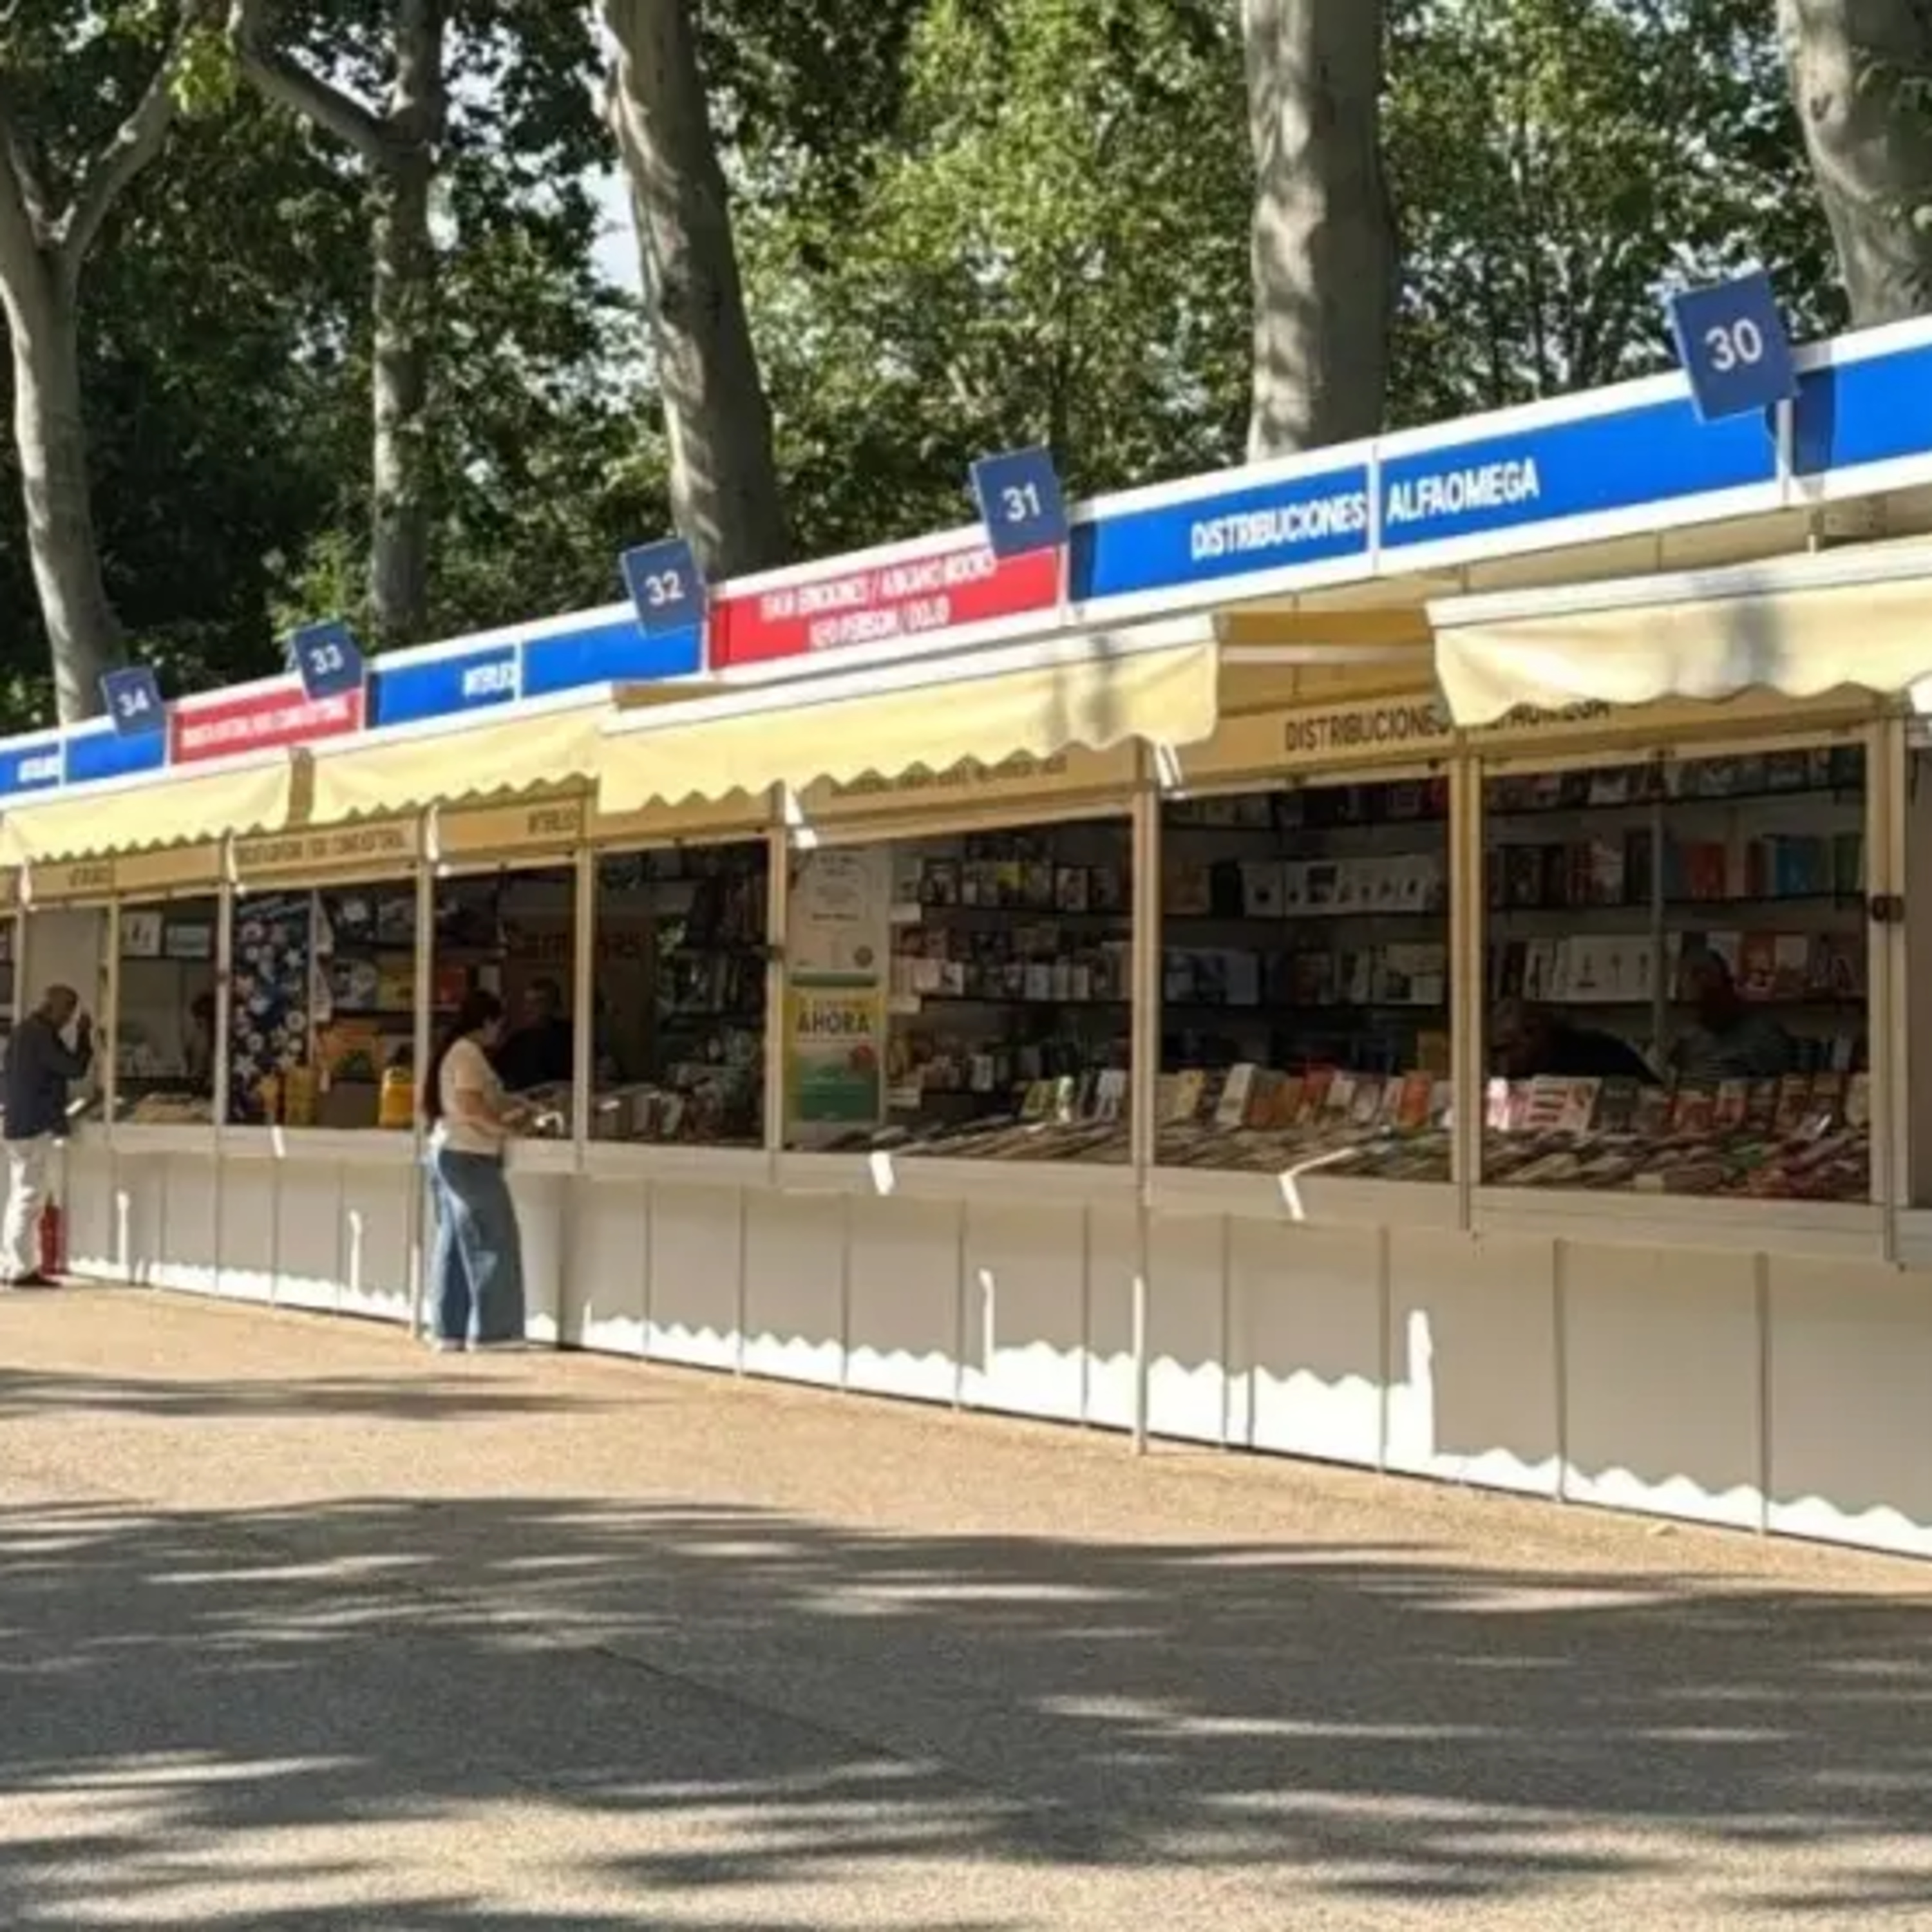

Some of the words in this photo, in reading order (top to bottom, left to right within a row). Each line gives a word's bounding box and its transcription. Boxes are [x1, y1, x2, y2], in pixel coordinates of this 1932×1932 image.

[1705, 317, 1763, 370] 30
[1003, 482, 1041, 522] 31
[1190, 492, 1367, 562] DISTRIBUCIONES
[1387, 457, 1540, 523] ALFAOMEGA
[645, 570, 685, 605] 32
[310, 645, 344, 675] 33
[118, 688, 149, 716] 34
[797, 1009, 871, 1036] AHORA
